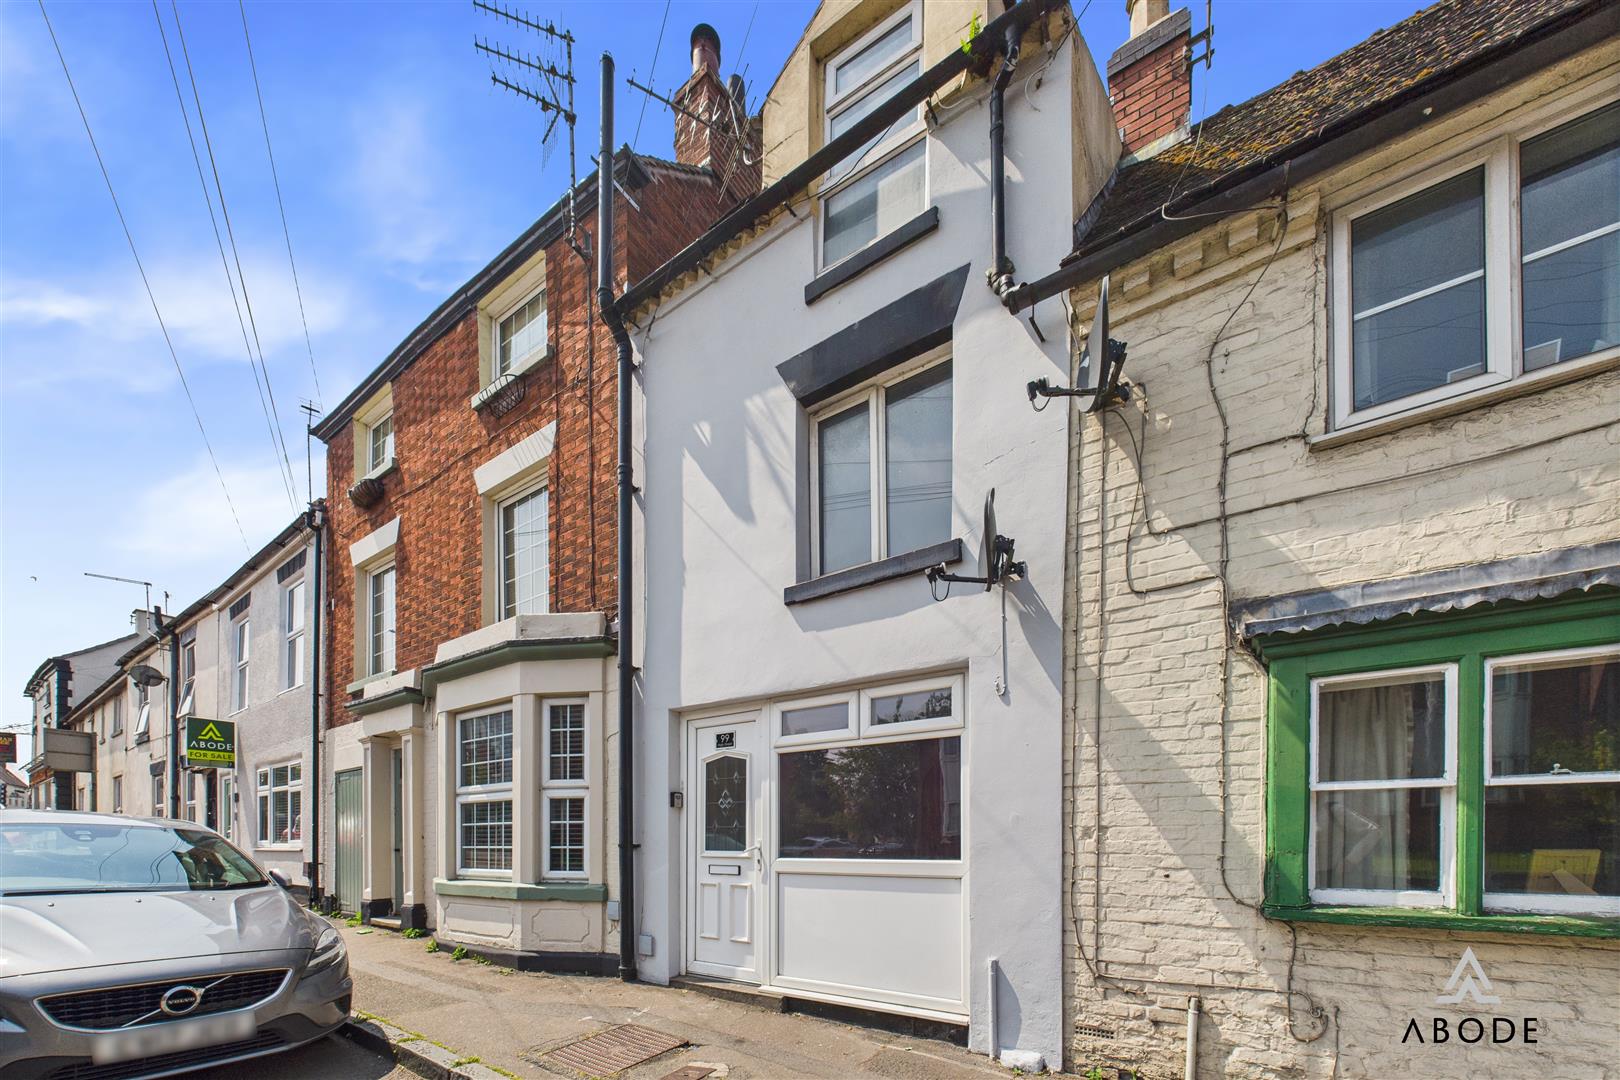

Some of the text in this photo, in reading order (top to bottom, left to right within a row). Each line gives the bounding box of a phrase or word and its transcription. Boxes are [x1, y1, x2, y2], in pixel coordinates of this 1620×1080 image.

[721, 734, 730, 743] 99
[190, 740, 233, 751] ABODE
[190, 751, 233, 760] FOR SALE
